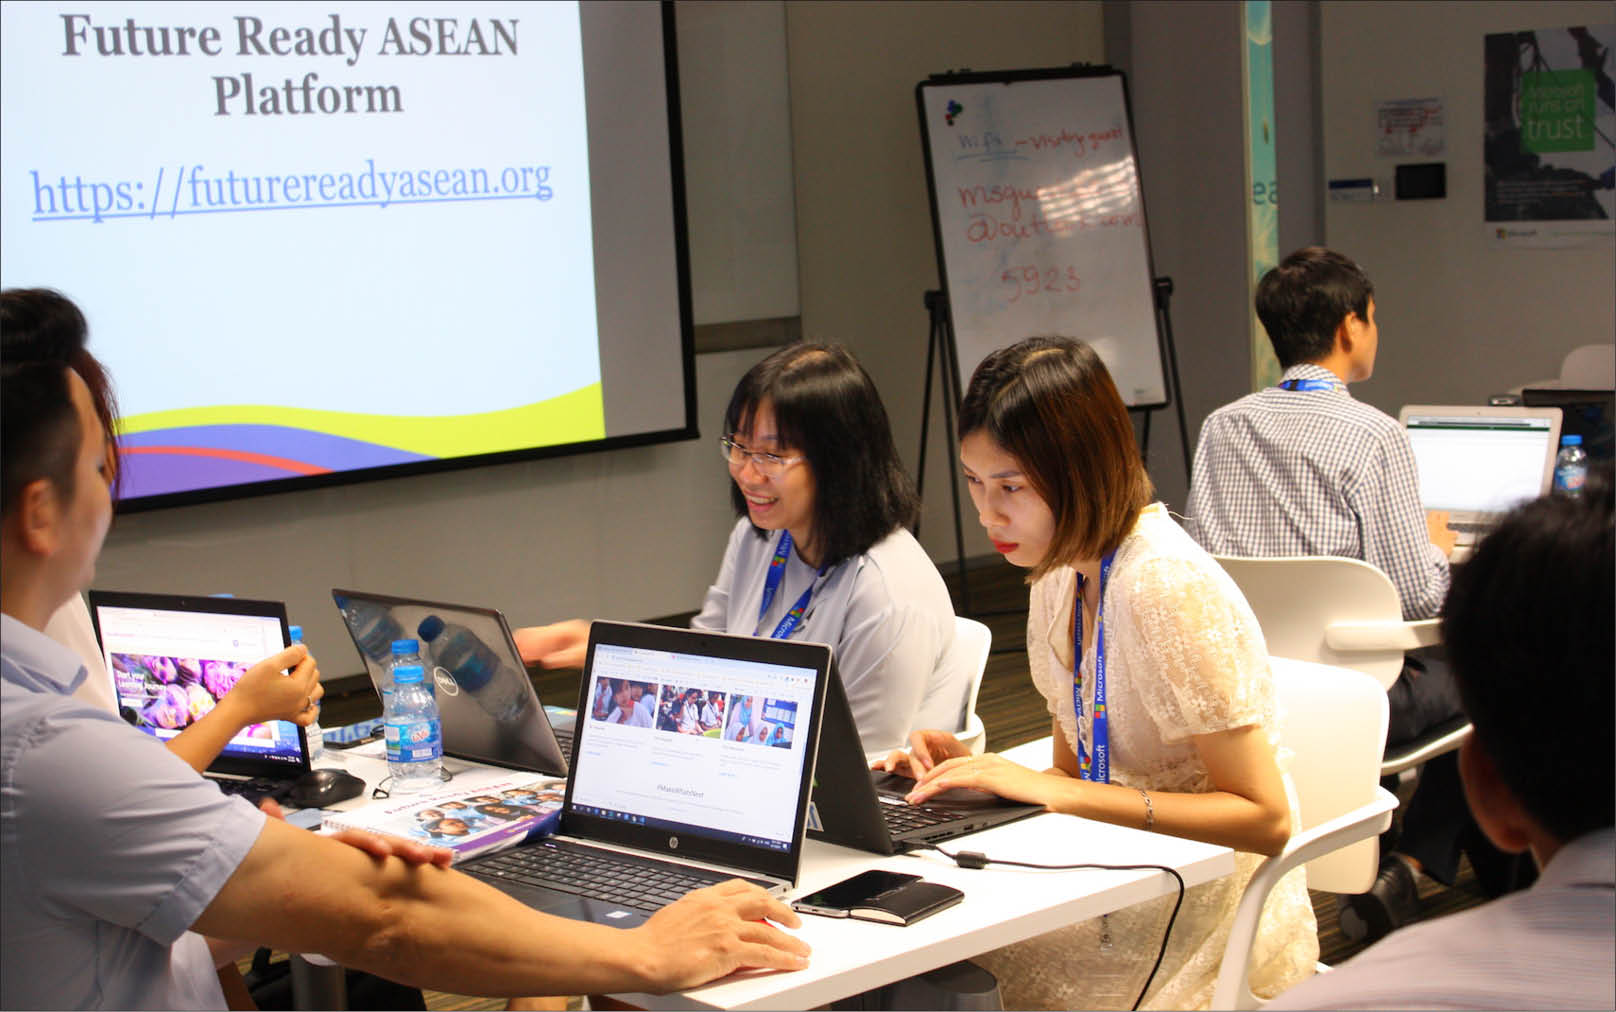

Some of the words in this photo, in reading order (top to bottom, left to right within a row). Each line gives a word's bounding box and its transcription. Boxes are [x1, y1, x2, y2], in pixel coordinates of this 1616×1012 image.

[59, 13, 223, 57] Future
[233, 14, 368, 67] Ready
[378, 17, 521, 56] ASEAN
[211, 72, 405, 116] Platform
[1527, 114, 1586, 141] trust
[29, 159, 554, 223] https://futurereadyasean.org
[1001, 263, 1081, 303] 5923
[1095, 744, 1105, 783] icrosoft
